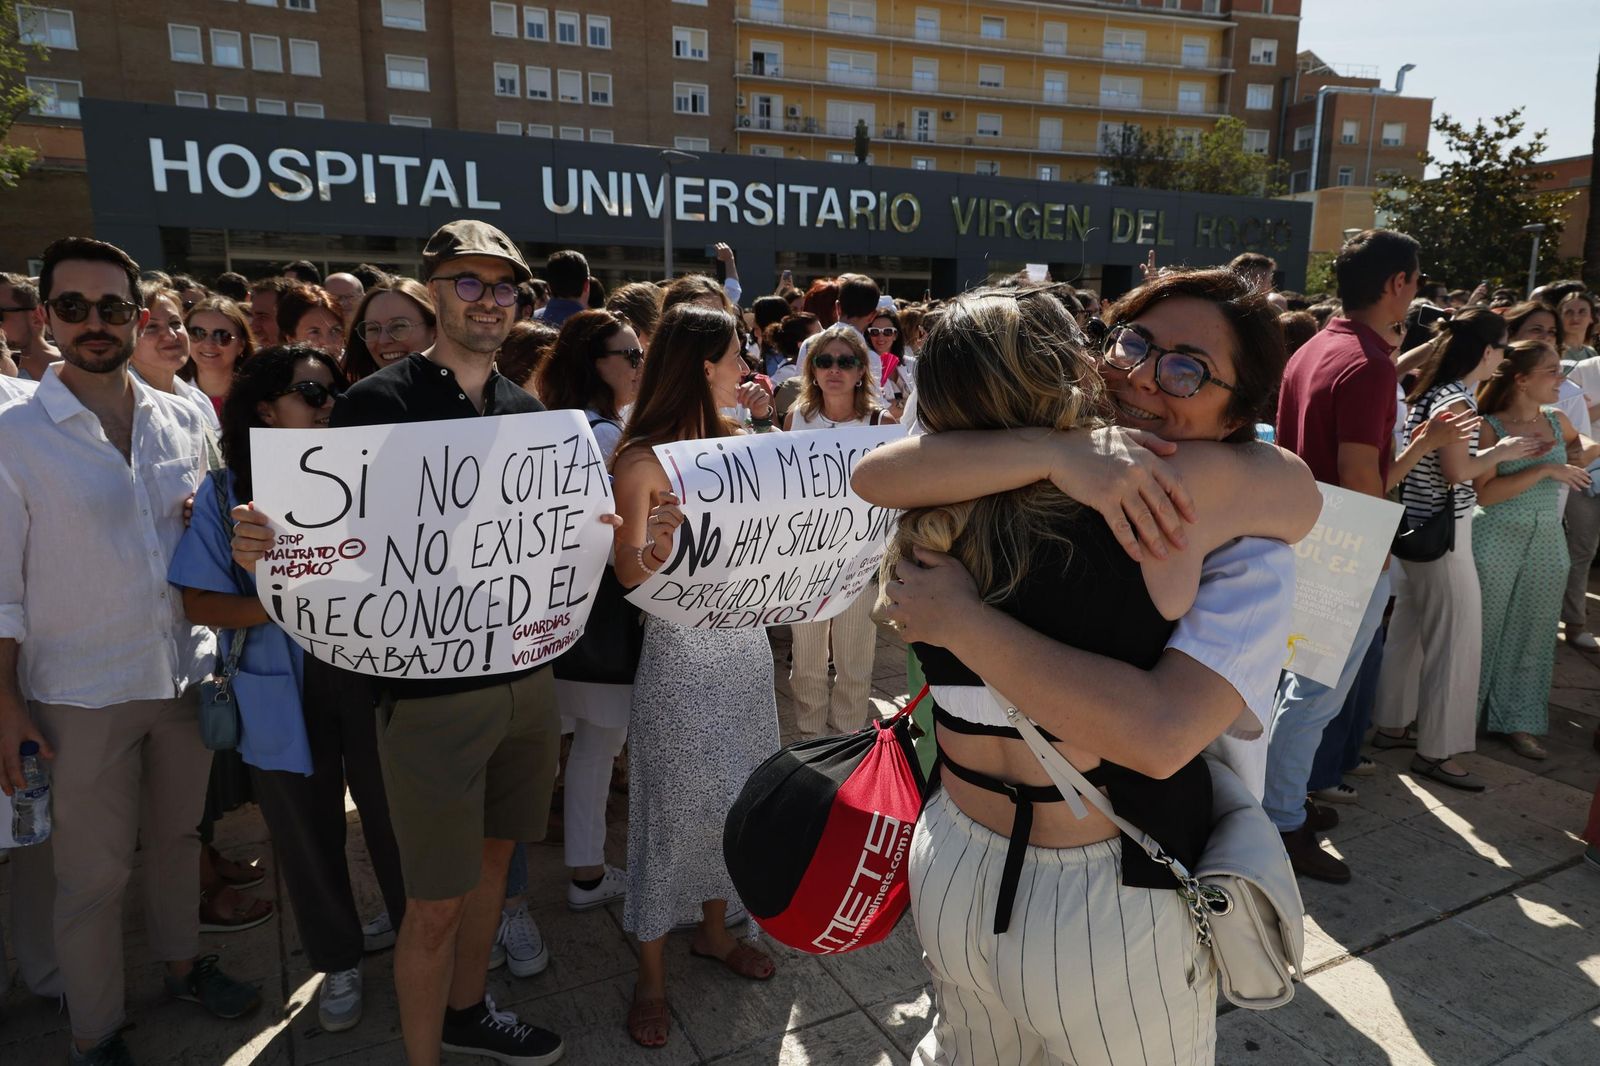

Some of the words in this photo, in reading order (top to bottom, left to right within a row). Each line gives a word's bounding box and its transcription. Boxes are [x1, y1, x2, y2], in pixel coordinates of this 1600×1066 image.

[149, 137, 500, 210] HOSPITAL
[541, 165, 921, 233] UNIVERSITARIO
[951, 196, 1091, 242] VIRGEN
[1111, 207, 1175, 246] DEL
[417, 445, 480, 516] NO
[776, 441, 886, 500] MÉDIC
[264, 546, 336, 561] MALTRATO
[277, 533, 304, 545] STOP
[381, 523, 448, 586] NO
[725, 513, 780, 568] HAY
[777, 507, 854, 556] SALUD,
[855, 505, 897, 541] SIN
[548, 565, 589, 610] EL
[650, 574, 770, 611] DERECHOS
[762, 567, 801, 608] NO
[803, 557, 847, 601] HAY
[293, 631, 497, 676] TRABAJO!
[811, 811, 900, 954] METS
